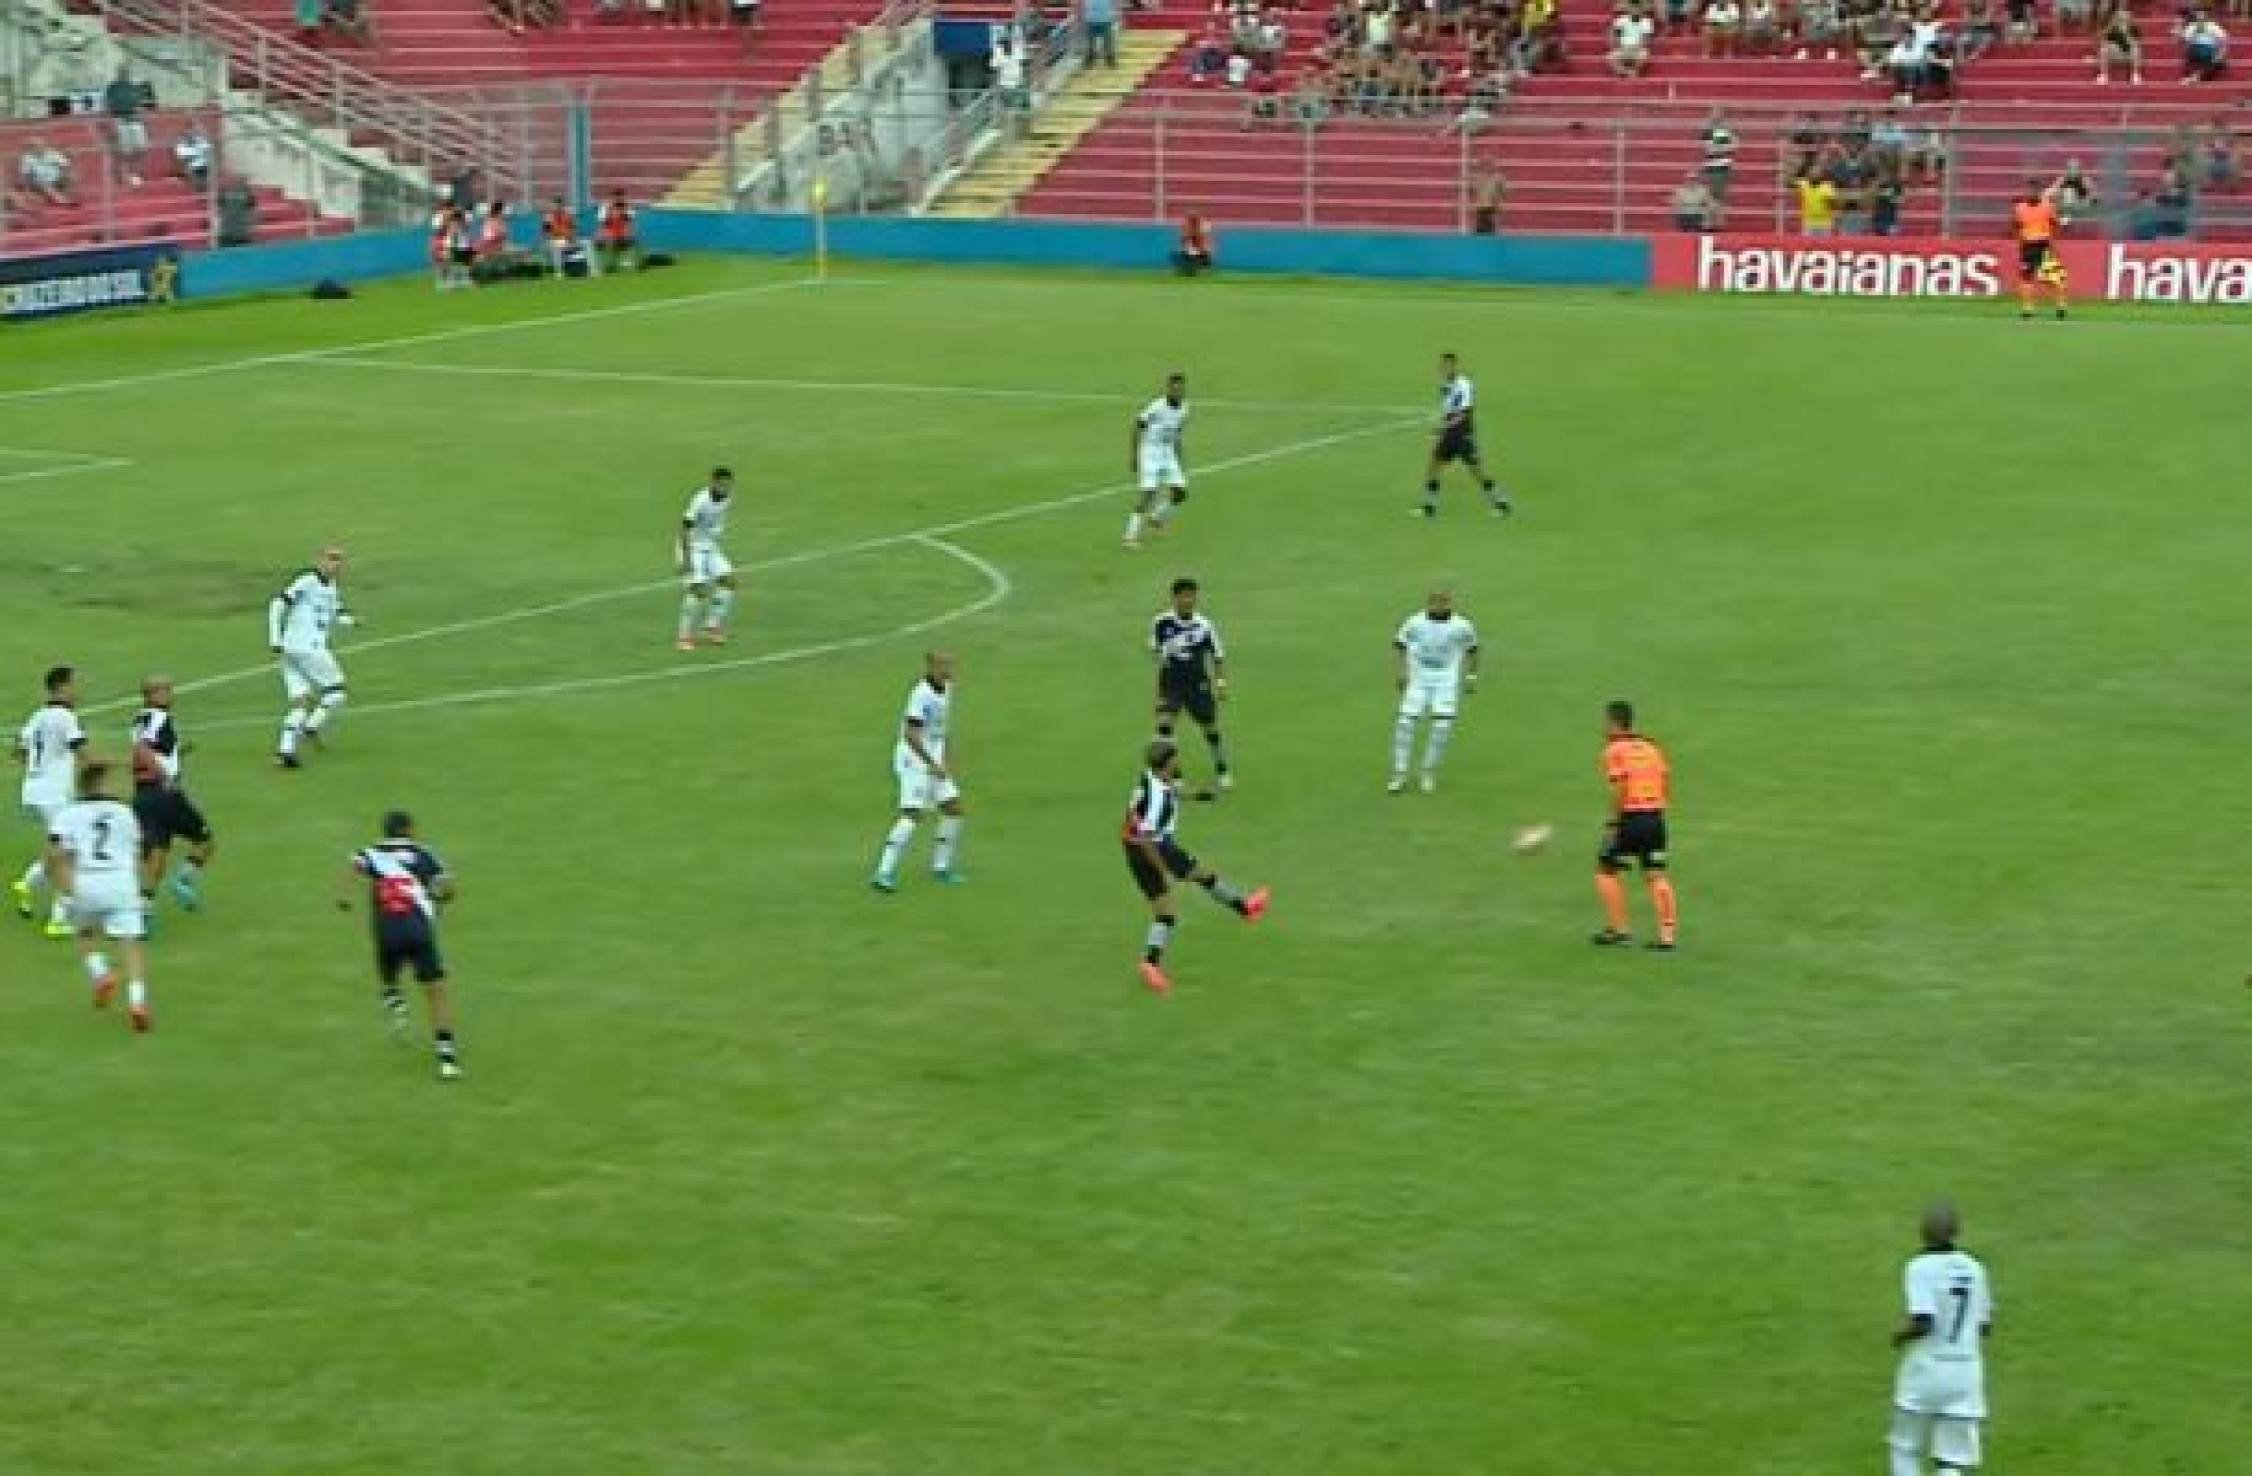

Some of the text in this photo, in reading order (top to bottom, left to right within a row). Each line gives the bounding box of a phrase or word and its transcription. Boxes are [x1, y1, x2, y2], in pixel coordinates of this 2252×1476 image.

[1698, 236, 1998, 297] havaianas
[2107, 243, 2252, 303] hava
[92, 820, 115, 861] 2
[1947, 1287, 1970, 1344] 7
